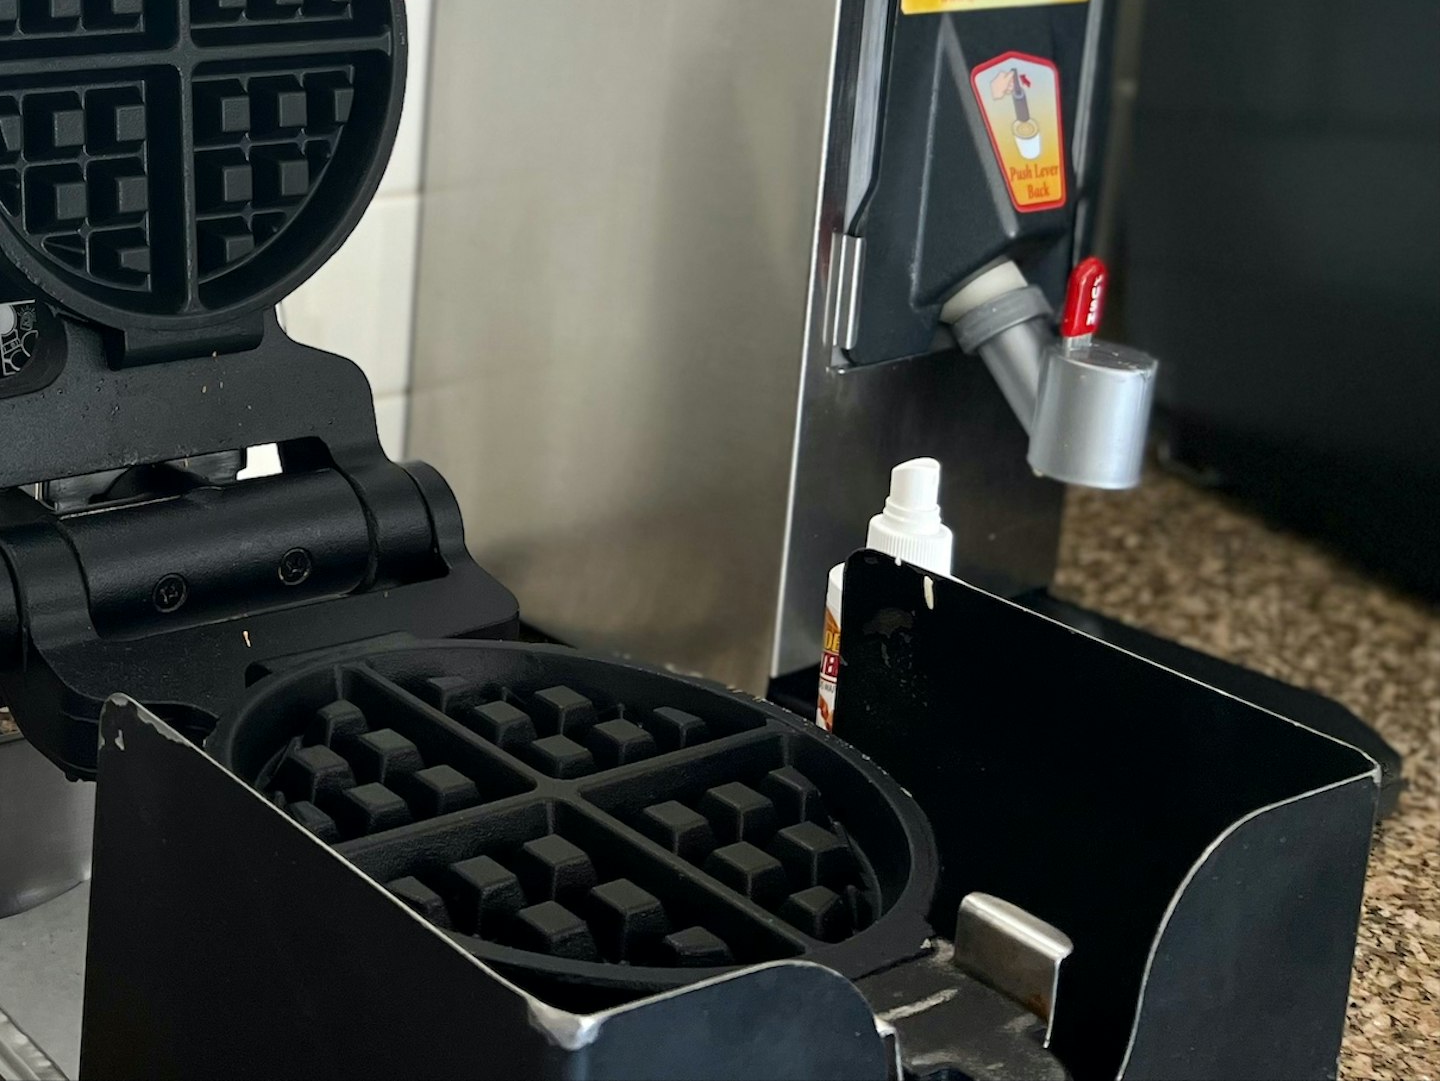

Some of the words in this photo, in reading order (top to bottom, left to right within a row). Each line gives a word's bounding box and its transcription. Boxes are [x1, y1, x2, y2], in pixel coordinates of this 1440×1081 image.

[1010, 164, 1033, 183] Push
[1034, 162, 1059, 180] Lever
[1027, 178, 1051, 200] Back
